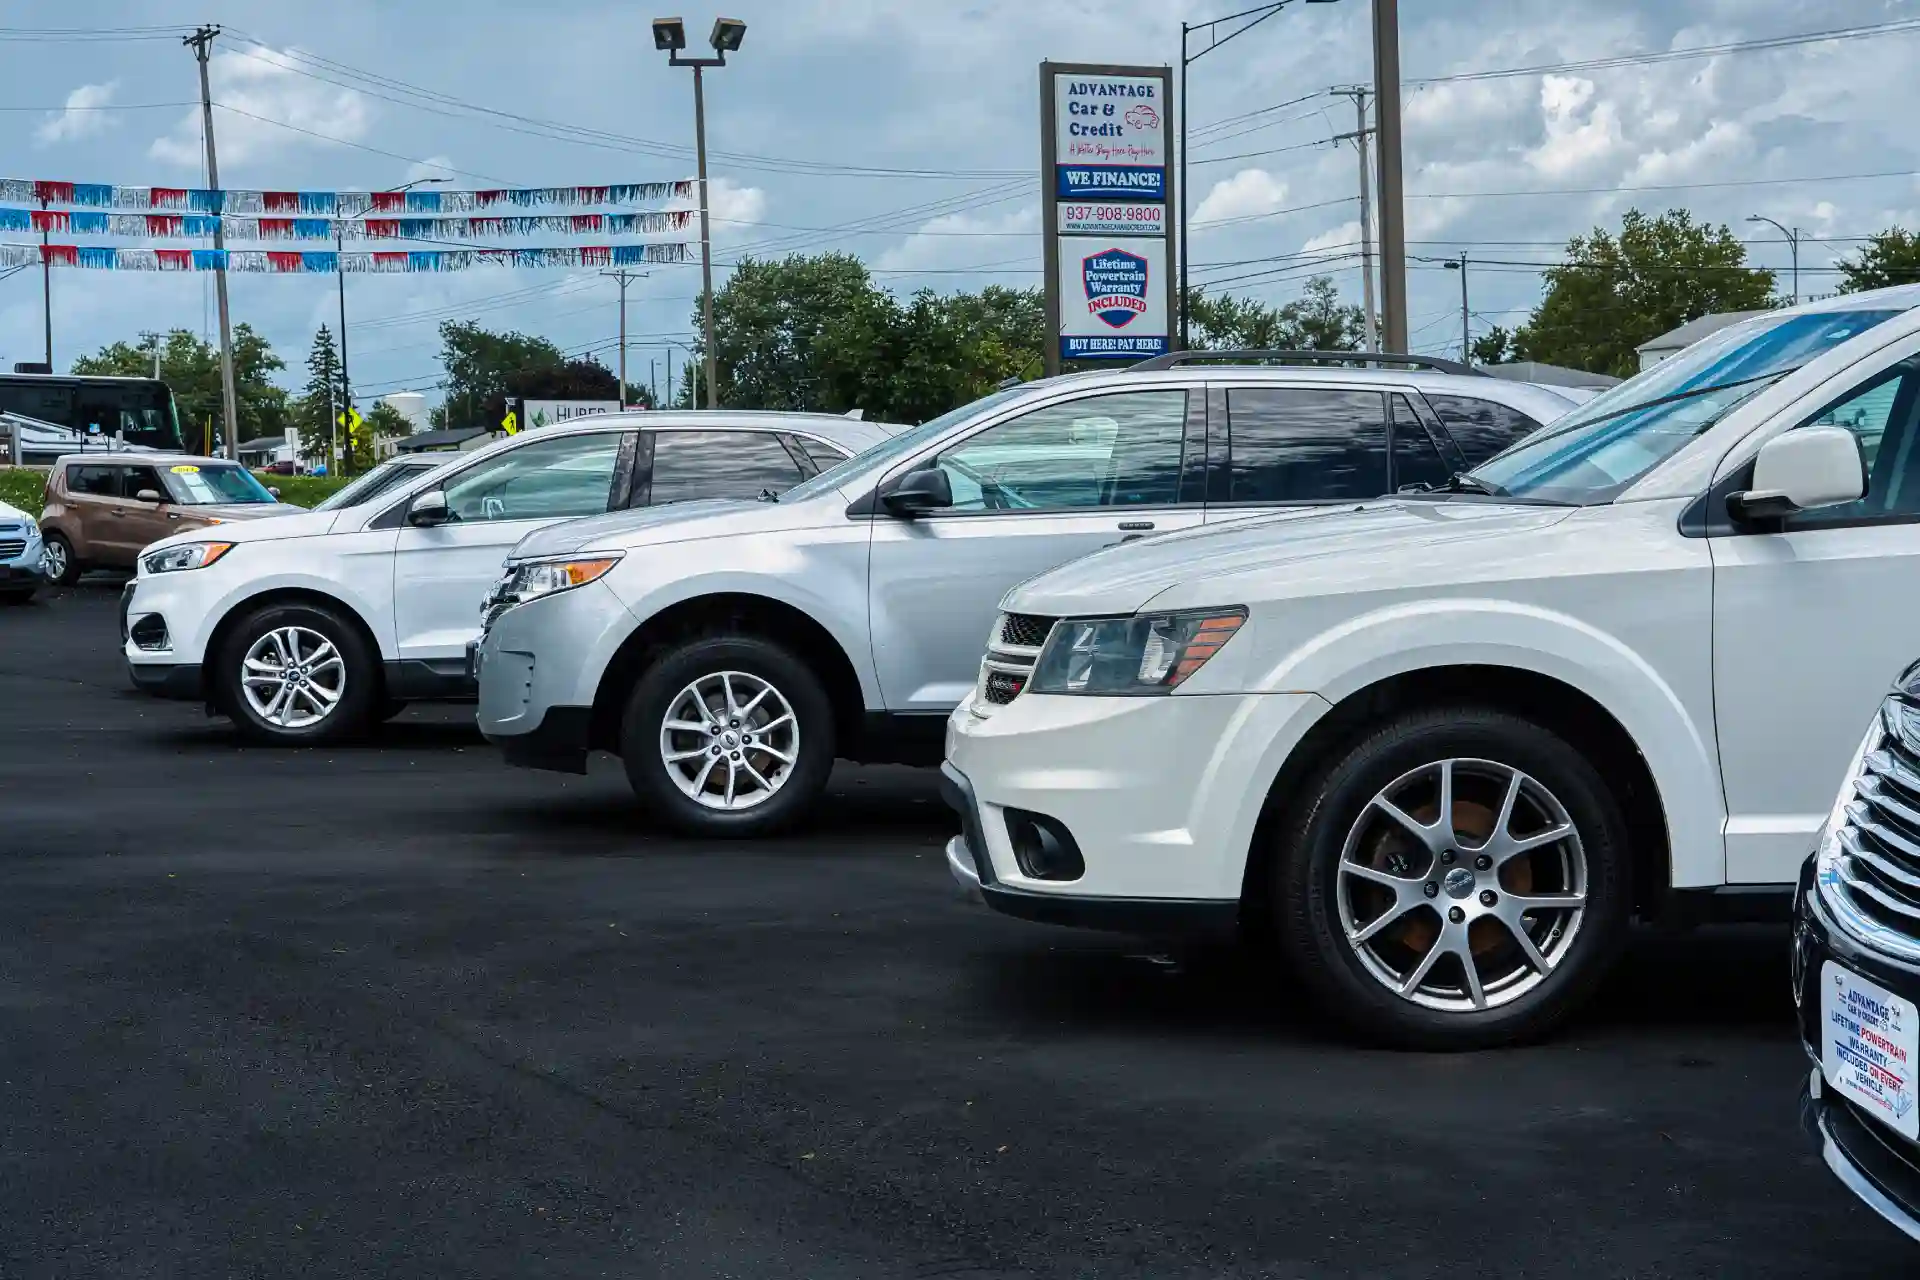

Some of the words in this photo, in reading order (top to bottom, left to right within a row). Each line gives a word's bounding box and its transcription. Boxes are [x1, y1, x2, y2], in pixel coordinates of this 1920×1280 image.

[1068, 82, 1154, 98] ADVANTAGE
[1069, 102, 1098, 116] Car
[1103, 104, 1115, 116] &
[1069, 122, 1124, 136] Credit
[1066, 171, 1090, 186] WE
[1092, 172, 1160, 187] FINANCE!
[1066, 206, 1160, 222] 937-908-9800
[1092, 258, 1136, 270] Lifetime
[1086, 270, 1146, 282] Powertrain
[1091, 282, 1142, 295] Warranty
[1088, 296, 1147, 313] INCLUDED
[1069, 338, 1089, 350] BUY
[1090, 338, 1116, 350] HERE!
[1118, 338, 1136, 350] PAY
[1136, 338, 1162, 350] HERE!
[1848, 988, 1890, 1021] ADVANTAGE
[1832, 1009, 1860, 1036] LIFETIME
[1861, 1028, 1906, 1064] POWERTRAIN
[1849, 1036, 1888, 1067] WARRANTY
[1836, 1046, 1868, 1072] INCLUDED
[1870, 1066, 1878, 1080] ON
[1881, 1073, 1900, 1092] EVERY
[1854, 1070, 1882, 1095] VEHICLE
